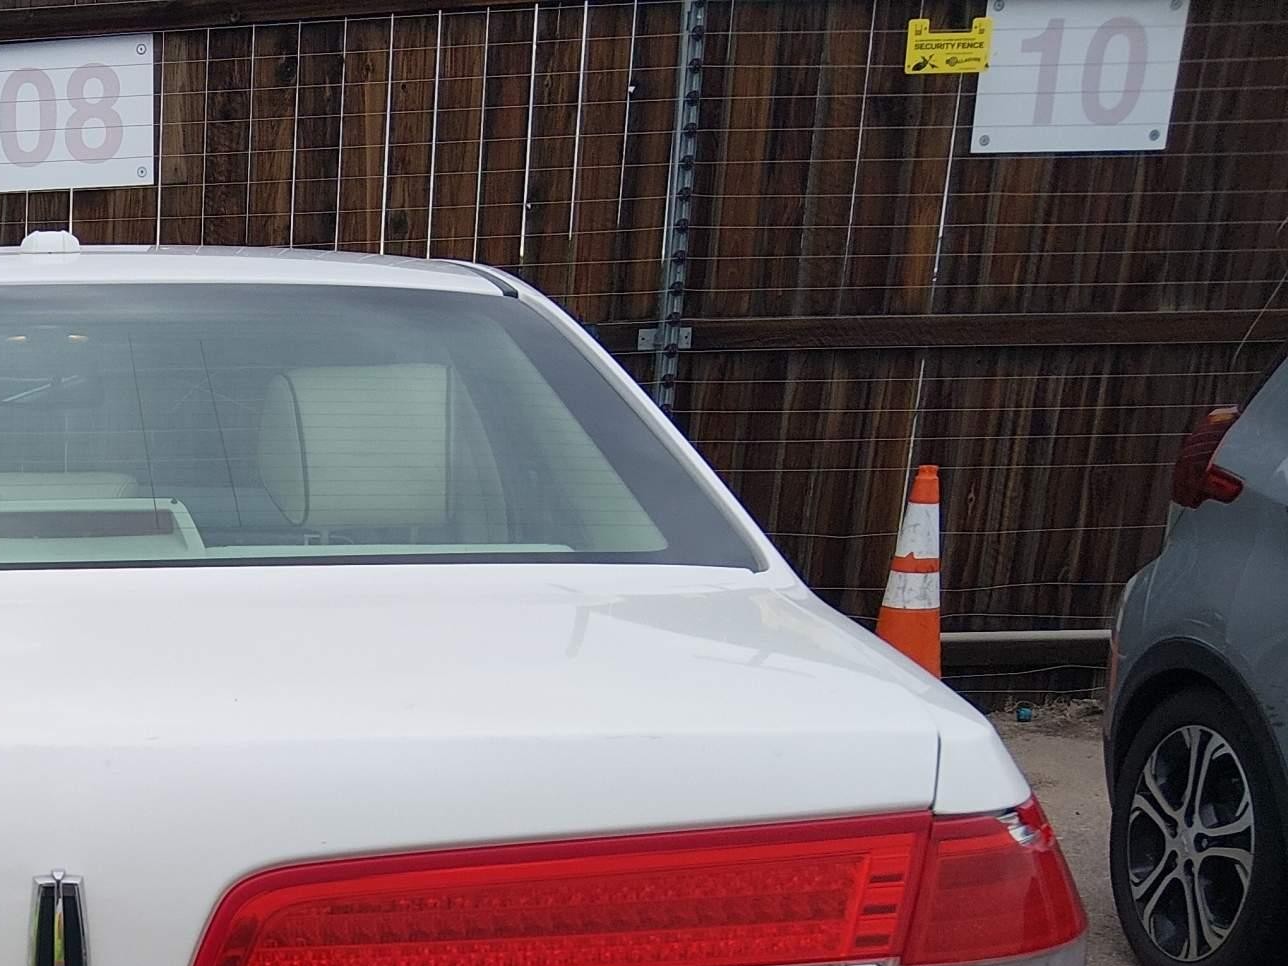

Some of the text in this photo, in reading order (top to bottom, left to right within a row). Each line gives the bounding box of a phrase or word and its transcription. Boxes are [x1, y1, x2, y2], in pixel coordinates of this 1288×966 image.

[914, 41, 985, 50] SECURITY FENCE
[1021, 16, 1148, 127] 10
[0, 62, 124, 167] 08
